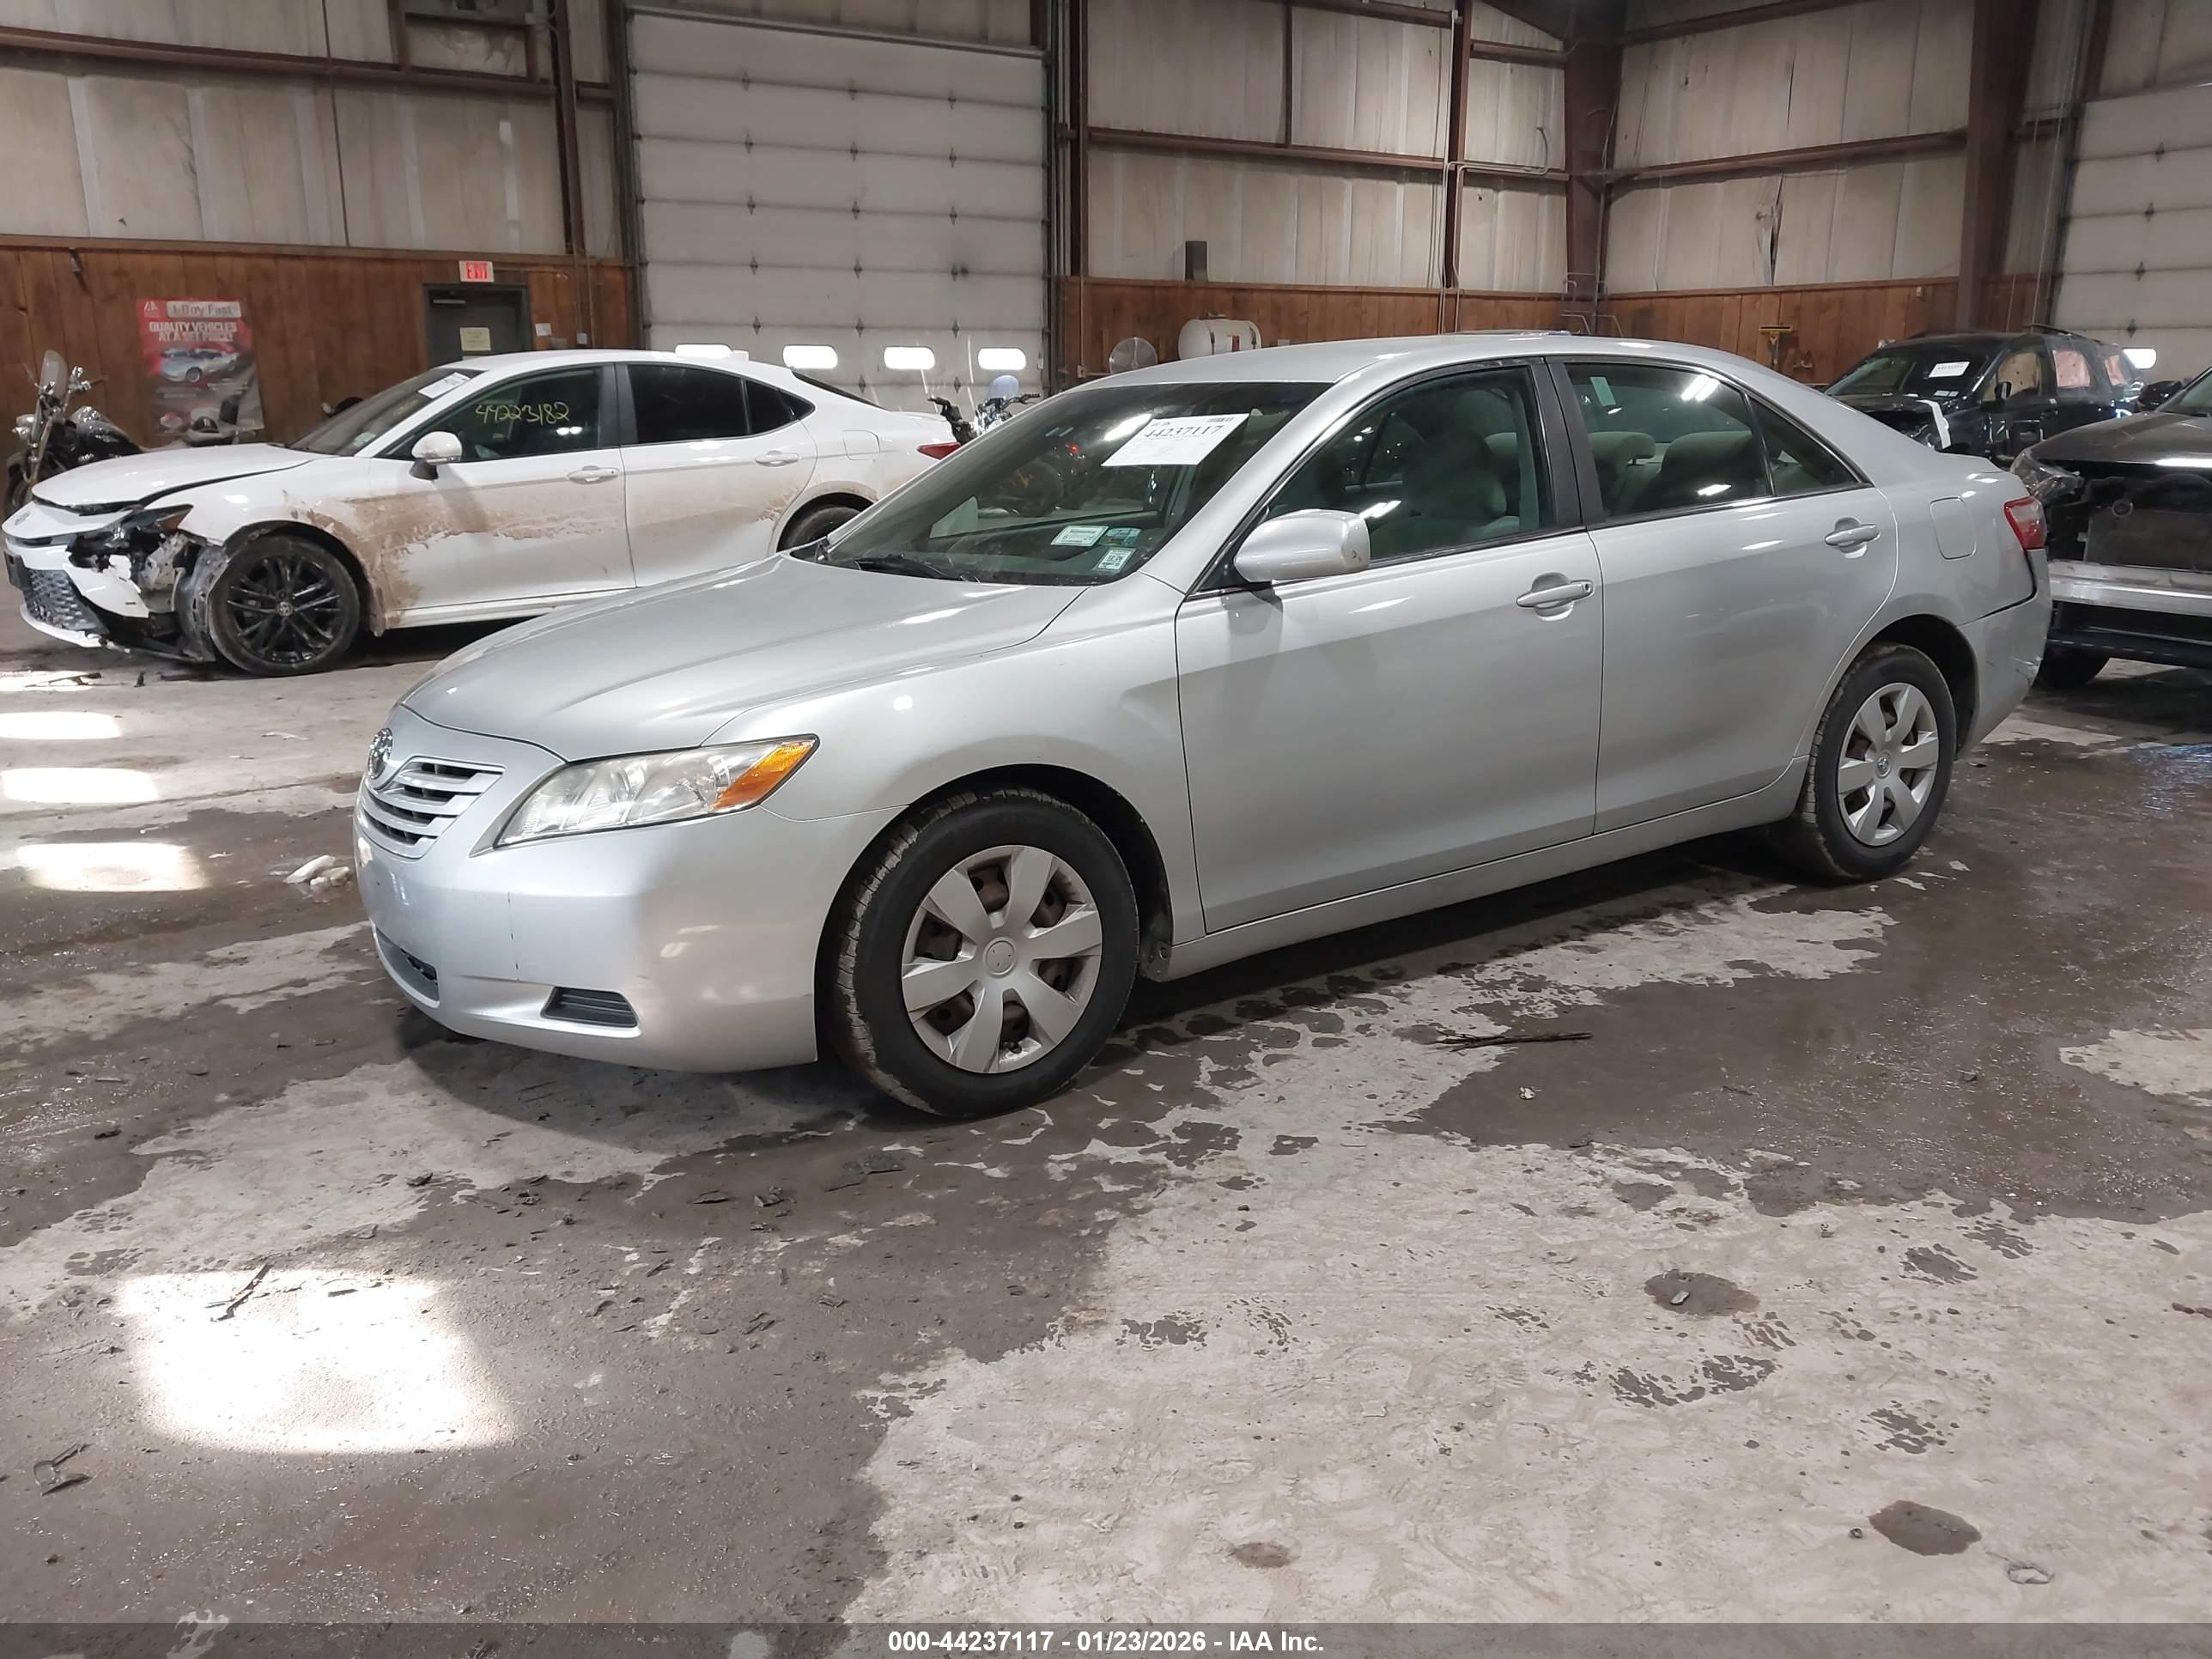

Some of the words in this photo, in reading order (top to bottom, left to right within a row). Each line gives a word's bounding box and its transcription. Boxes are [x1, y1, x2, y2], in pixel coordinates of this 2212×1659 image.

[149, 321, 191, 332] QUALITY
[191, 322, 237, 333] VEHICLES
[475, 402, 570, 426] 44223182
[1144, 425, 1224, 437] 44237117
